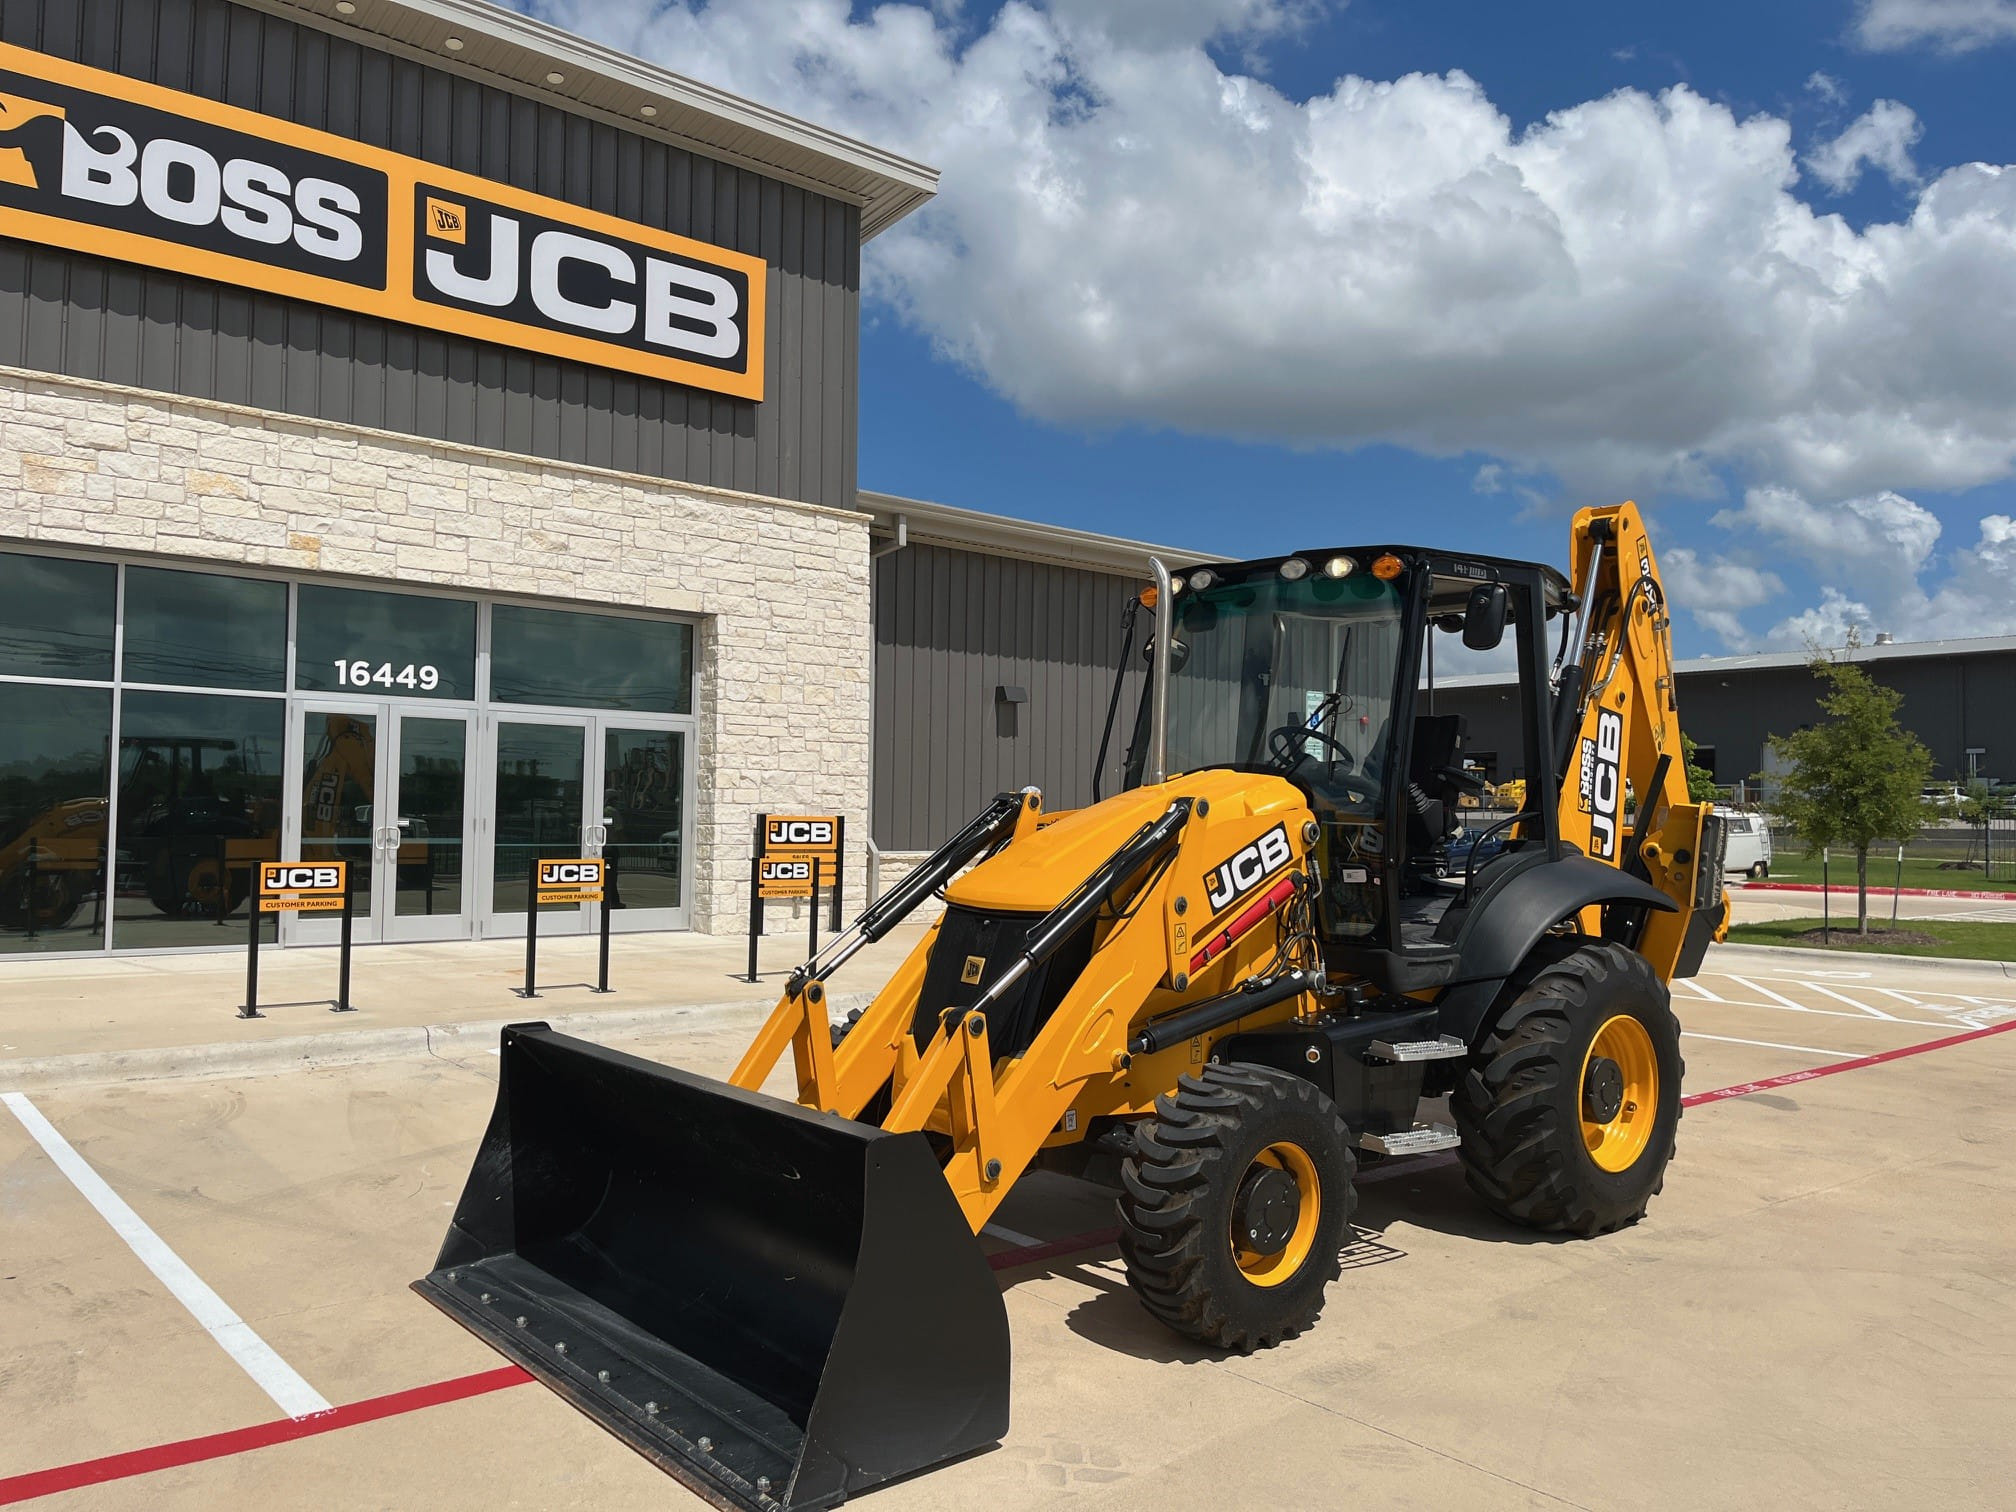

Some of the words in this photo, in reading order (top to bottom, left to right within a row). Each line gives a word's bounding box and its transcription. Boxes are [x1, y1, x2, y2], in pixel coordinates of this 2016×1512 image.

[61, 120, 363, 261] BOSS
[436, 209, 460, 229] JCB
[426, 214, 741, 359] JCB
[334, 660, 439, 690] 16449
[1580, 739, 1592, 796] BOSS
[1593, 712, 1621, 857] JCB
[770, 822, 831, 842] JCB
[267, 868, 338, 888] JCB
[542, 864, 598, 882] JCB
[762, 863, 808, 879] JCB
[1210, 828, 1290, 908] JCB
[265, 901, 305, 909] CUSTOMER
